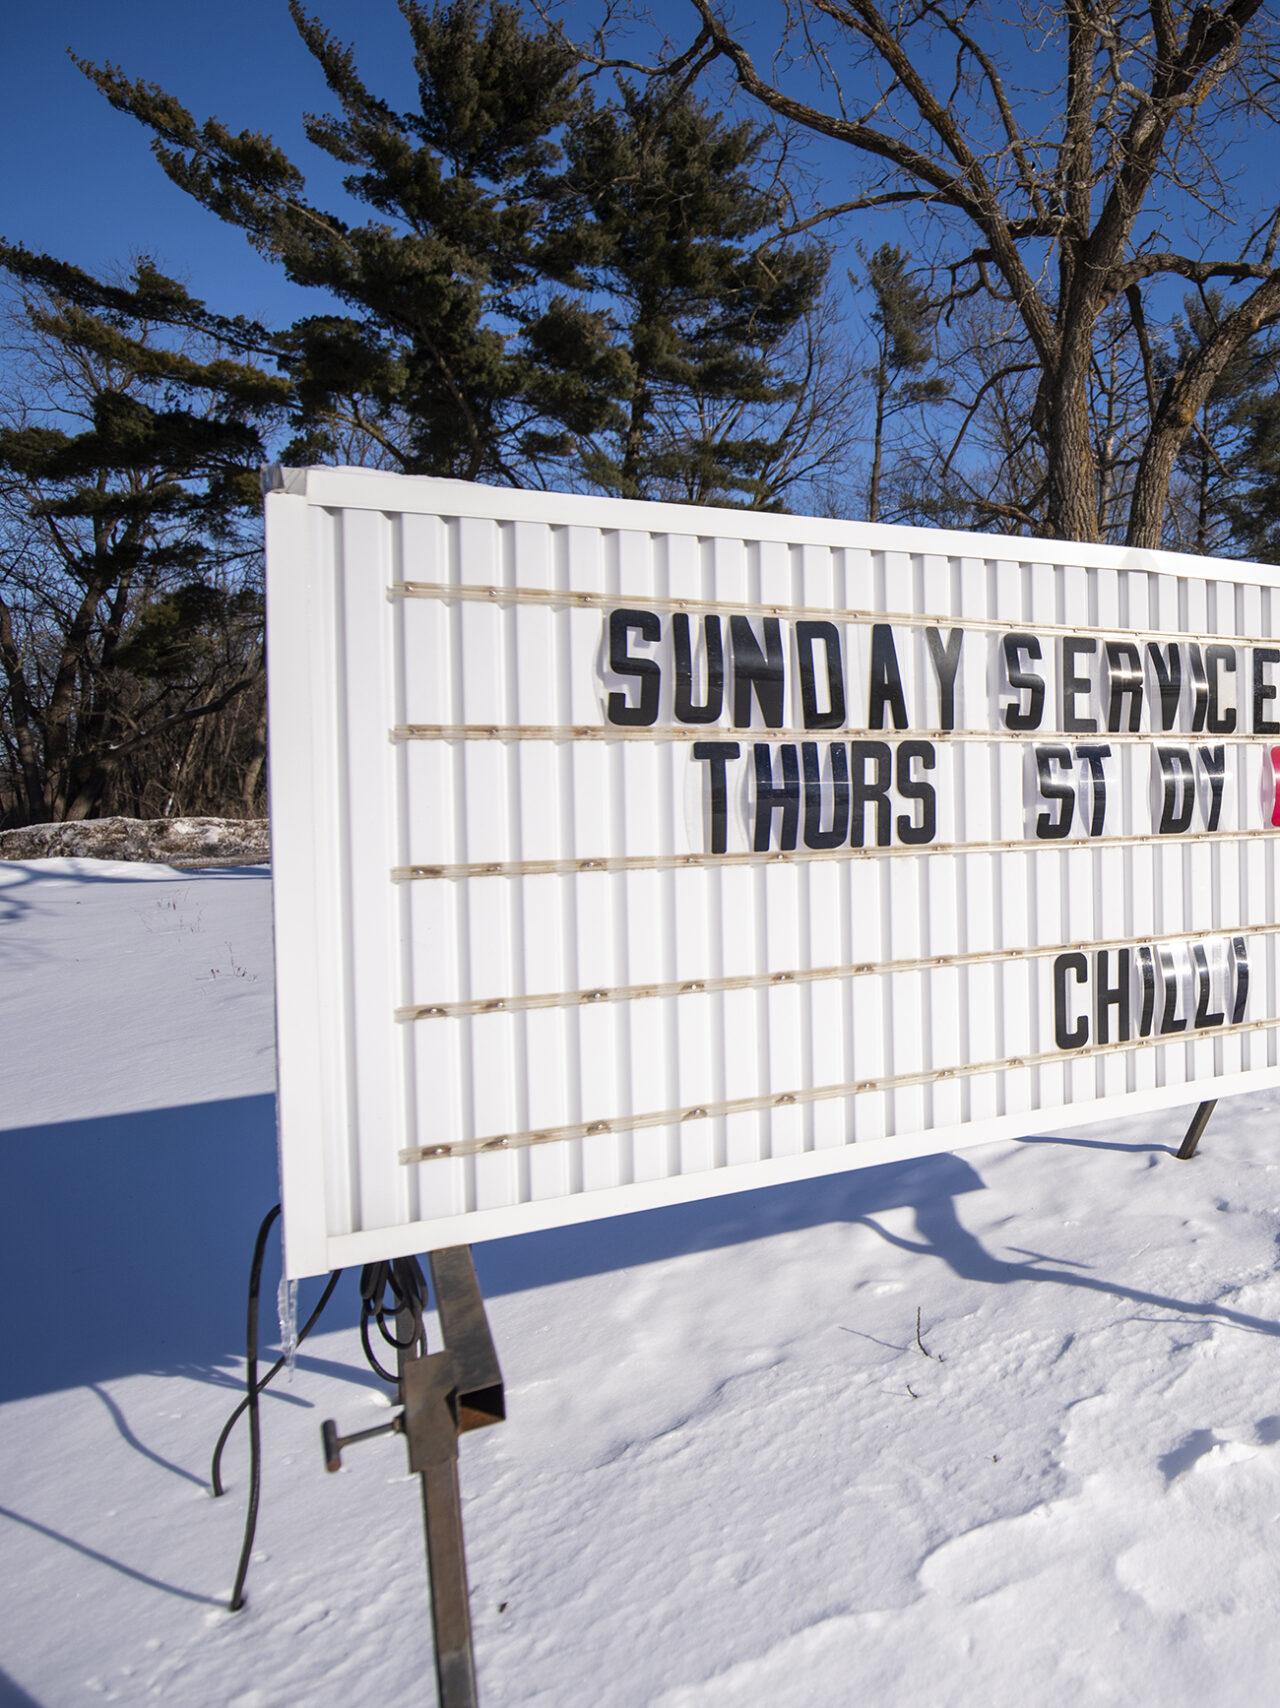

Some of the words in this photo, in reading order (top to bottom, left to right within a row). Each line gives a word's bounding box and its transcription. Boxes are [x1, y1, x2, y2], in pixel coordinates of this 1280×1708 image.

[608, 609, 964, 731] SUNDAY
[1003, 633, 1280, 734] SERVICE
[693, 740, 937, 854] THURS
[1053, 936, 1249, 1050] CHILLI
